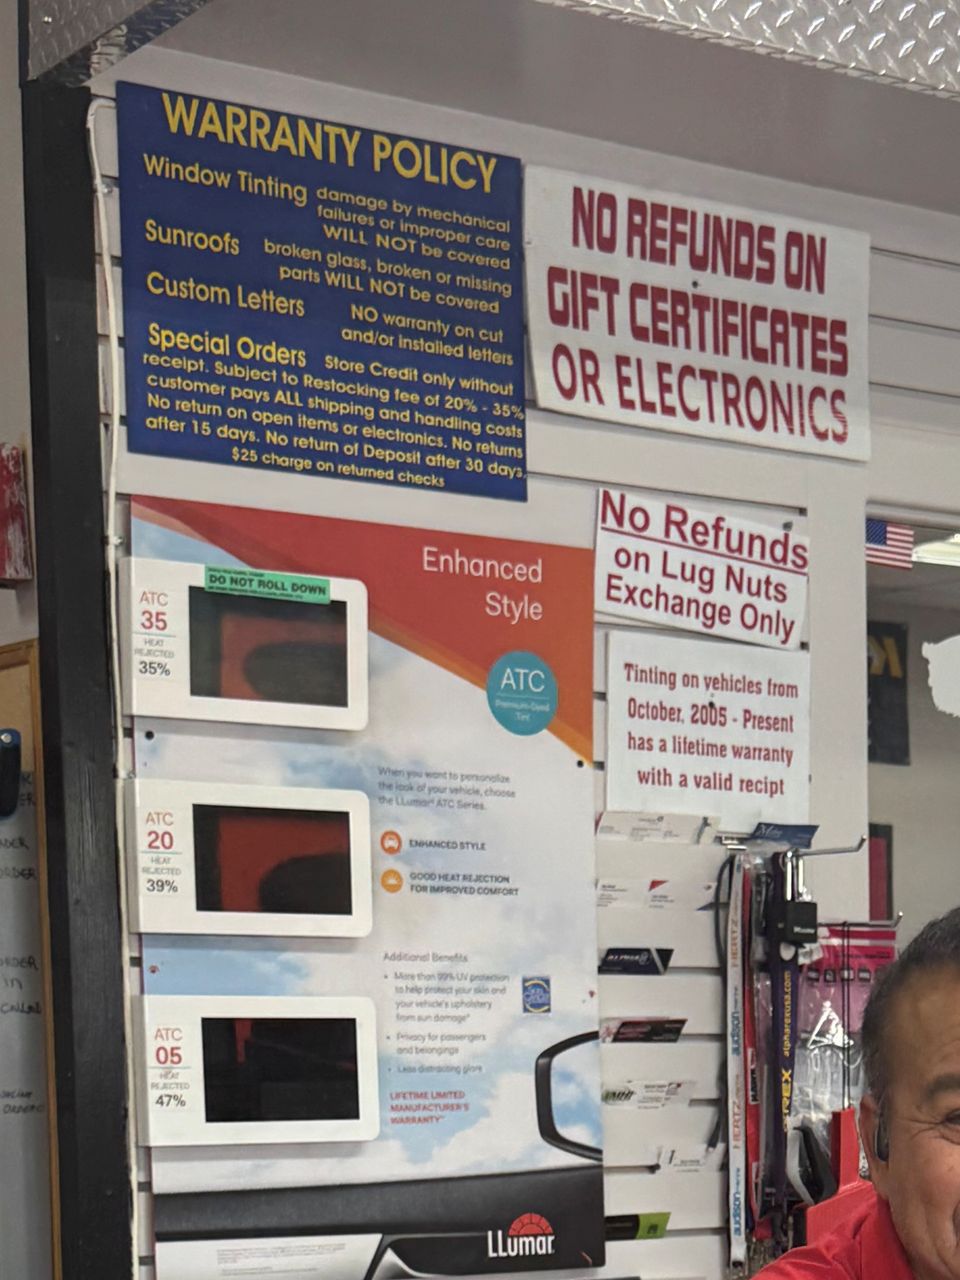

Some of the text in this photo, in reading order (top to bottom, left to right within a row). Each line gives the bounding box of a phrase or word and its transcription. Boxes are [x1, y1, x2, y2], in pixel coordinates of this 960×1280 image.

[162, 92, 497, 193] WARRANTY POLICY
[143, 153, 307, 207] Window Tinting
[145, 218, 239, 255] Sunroofs
[323, 225, 510, 270] WILL NOT be covered
[572, 186, 826, 294] NO REFUNDS ON
[147, 272, 305, 317] Custom Letters
[351, 304, 503, 344] NO warranty on cut
[547, 266, 848, 377] GIFT CERTIFICATES
[149, 323, 306, 367] Special Orders
[552, 343, 848, 444] OR ELECTRONICS
[146, 416, 186, 433] after
[192, 420, 211, 436] 15
[217, 424, 260, 443] days.
[266, 431, 288, 446] No
[294, 434, 339, 454] return
[344, 443, 359, 456] of
[364, 444, 421, 464] Deposit
[425, 453, 460, 470] after
[465, 458, 484, 473] 30
[232, 446, 446, 488] $25 charge on returned checks
[600, 489, 808, 570] No Refunds
[422, 546, 543, 584] Enhanced
[615, 547, 788, 604] on Lug Nuts
[140, 591, 168, 607] ATC
[209, 573, 226, 586] DO
[230, 576, 254, 589] NOT
[258, 579, 287, 593] ROLL
[291, 582, 327, 597] DOWN
[141, 610, 167, 631] 35
[485, 591, 543, 624] Style
[606, 573, 796, 645] Exchange Only
[139, 660, 171, 677] 35%
[501, 667, 545, 692] ATC
[624, 662, 798, 699] Tinting on vehicles from
[690, 704, 727, 728] 2005
[743, 709, 794, 734] Present
[628, 731, 793, 768] has a lifetime warranty
[638, 767, 784, 799] with a valid recipt
[146, 812, 174, 827] ATC
[147, 831, 173, 850] 20
[409, 839, 486, 851] ENHANCED STYLE
[146, 879, 178, 893] 39%
[154, 1027, 183, 1042] ATC
[155, 1046, 183, 1066] 05
[155, 1092, 187, 1108] 47%
[390, 1090, 466, 1101] LIFETIME LIMITED
[487, 1229, 555, 1258] LLumar
